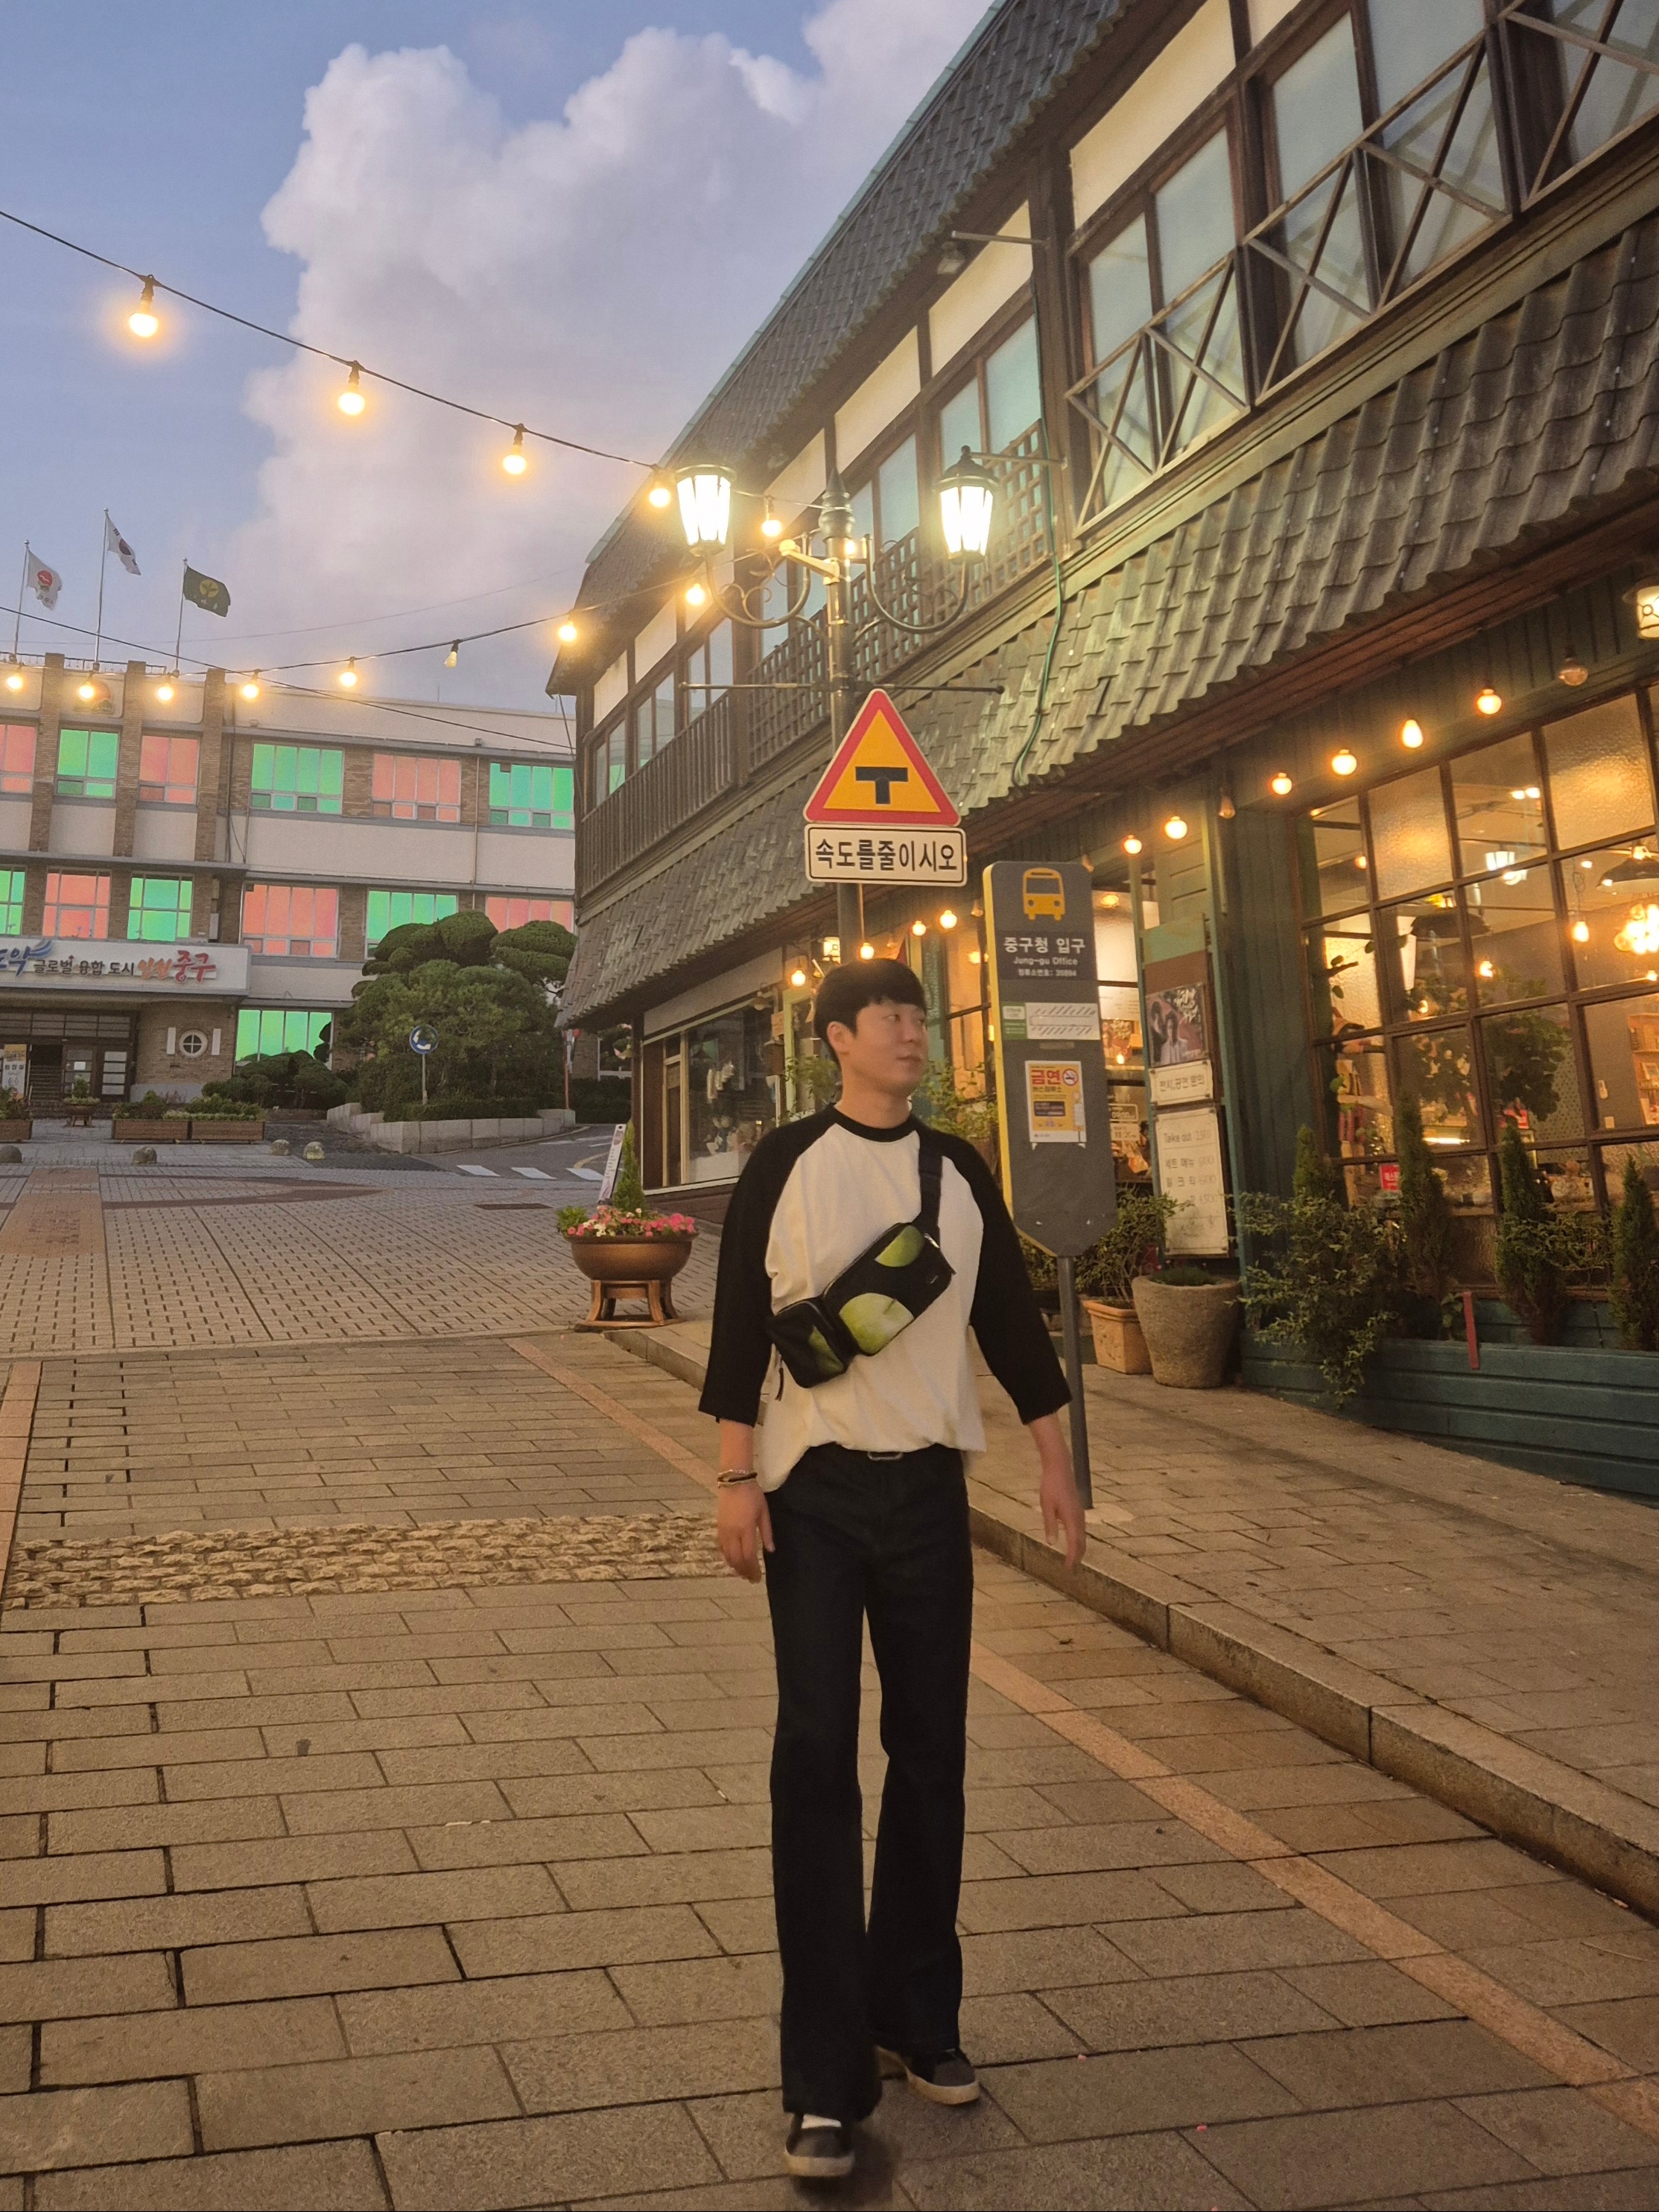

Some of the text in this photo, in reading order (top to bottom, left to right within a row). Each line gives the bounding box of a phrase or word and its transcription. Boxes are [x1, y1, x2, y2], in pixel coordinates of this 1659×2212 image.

[815, 839, 958, 872] 속도를줄이시오
[1003, 937, 1086, 954] 중구청 입구
[34, 957, 73, 975] 글로벌
[108, 962, 135, 976] 도시
[138, 957, 173, 979] 인천
[173, 949, 216, 983] 중구
[1052, 957, 1079, 965] Office
[1031, 1070, 1062, 1085] 금연
[1164, 1133, 1181, 1142] Take
